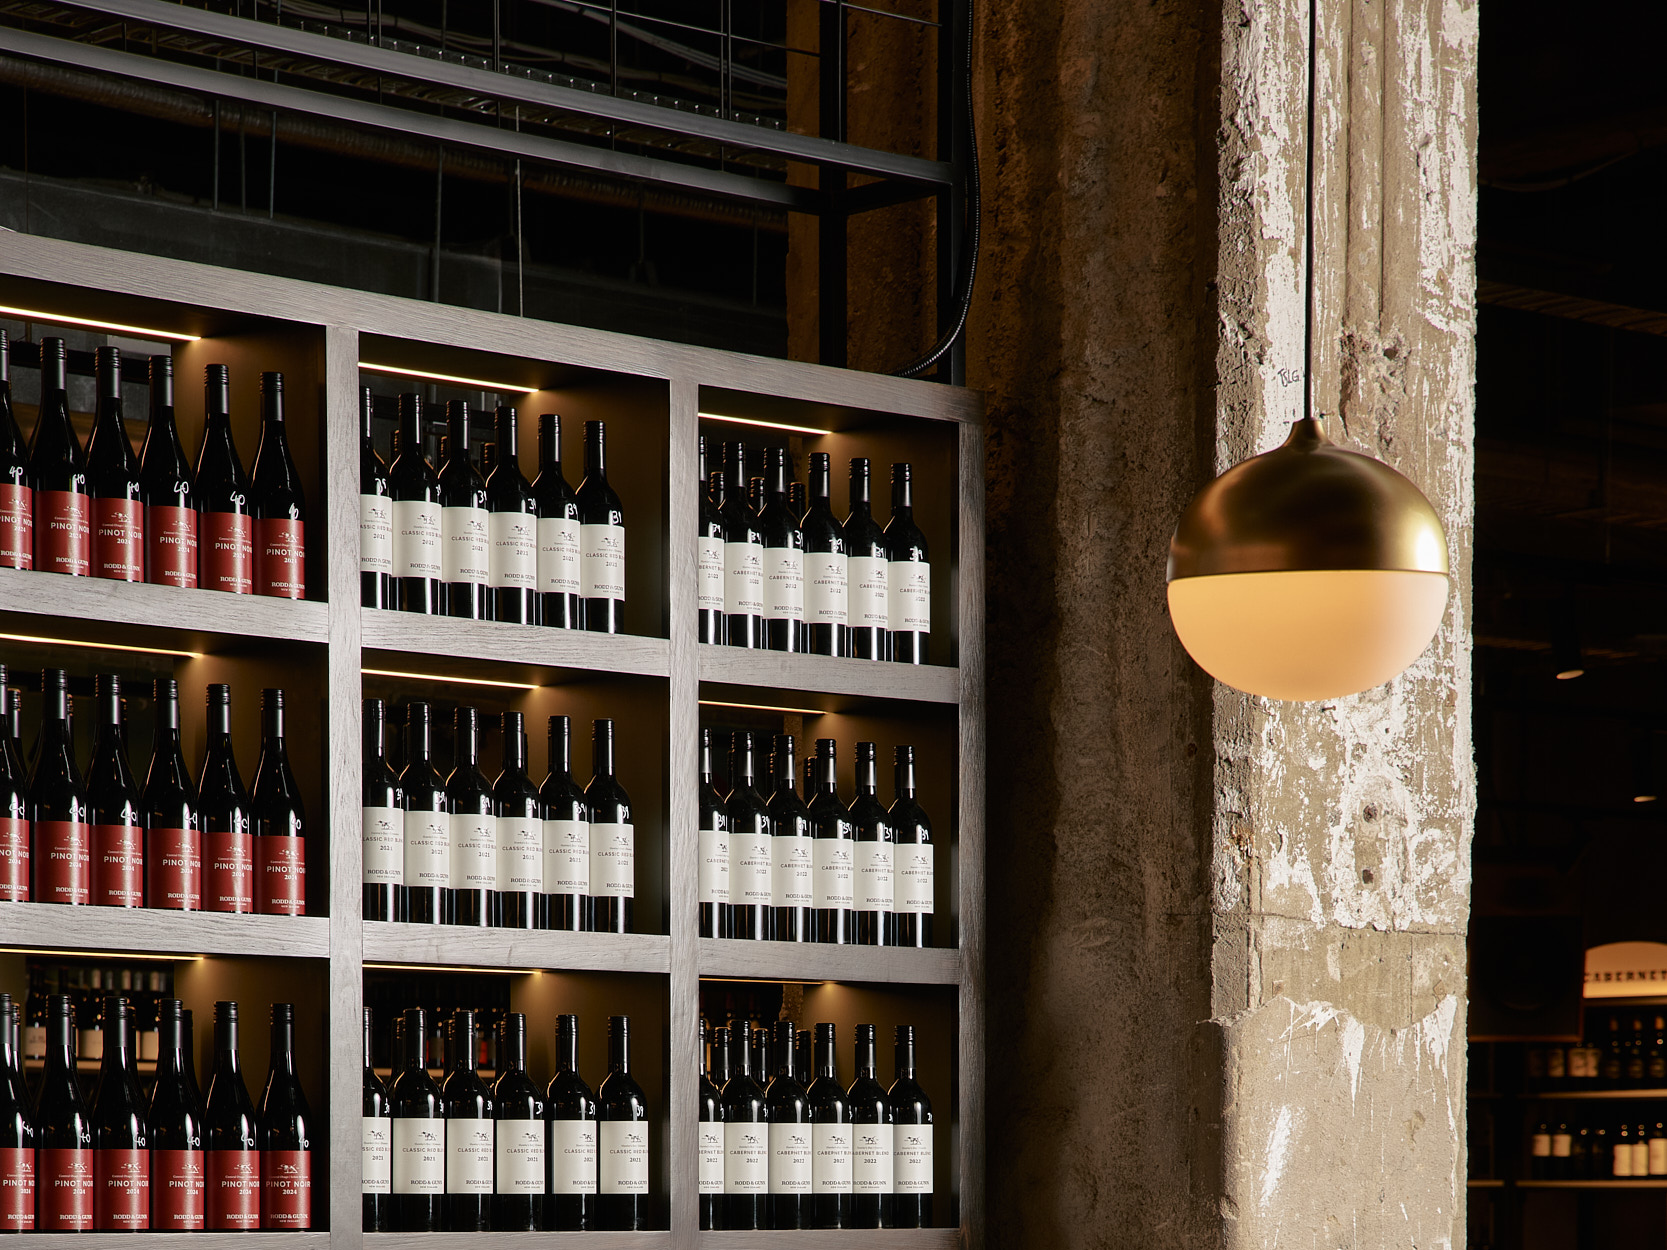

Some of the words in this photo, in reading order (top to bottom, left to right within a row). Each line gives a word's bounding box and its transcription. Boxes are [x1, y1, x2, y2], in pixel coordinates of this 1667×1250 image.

[174, 481, 189, 493] 40
[230, 491, 245, 505] 40
[51, 522, 76, 530] PINOT
